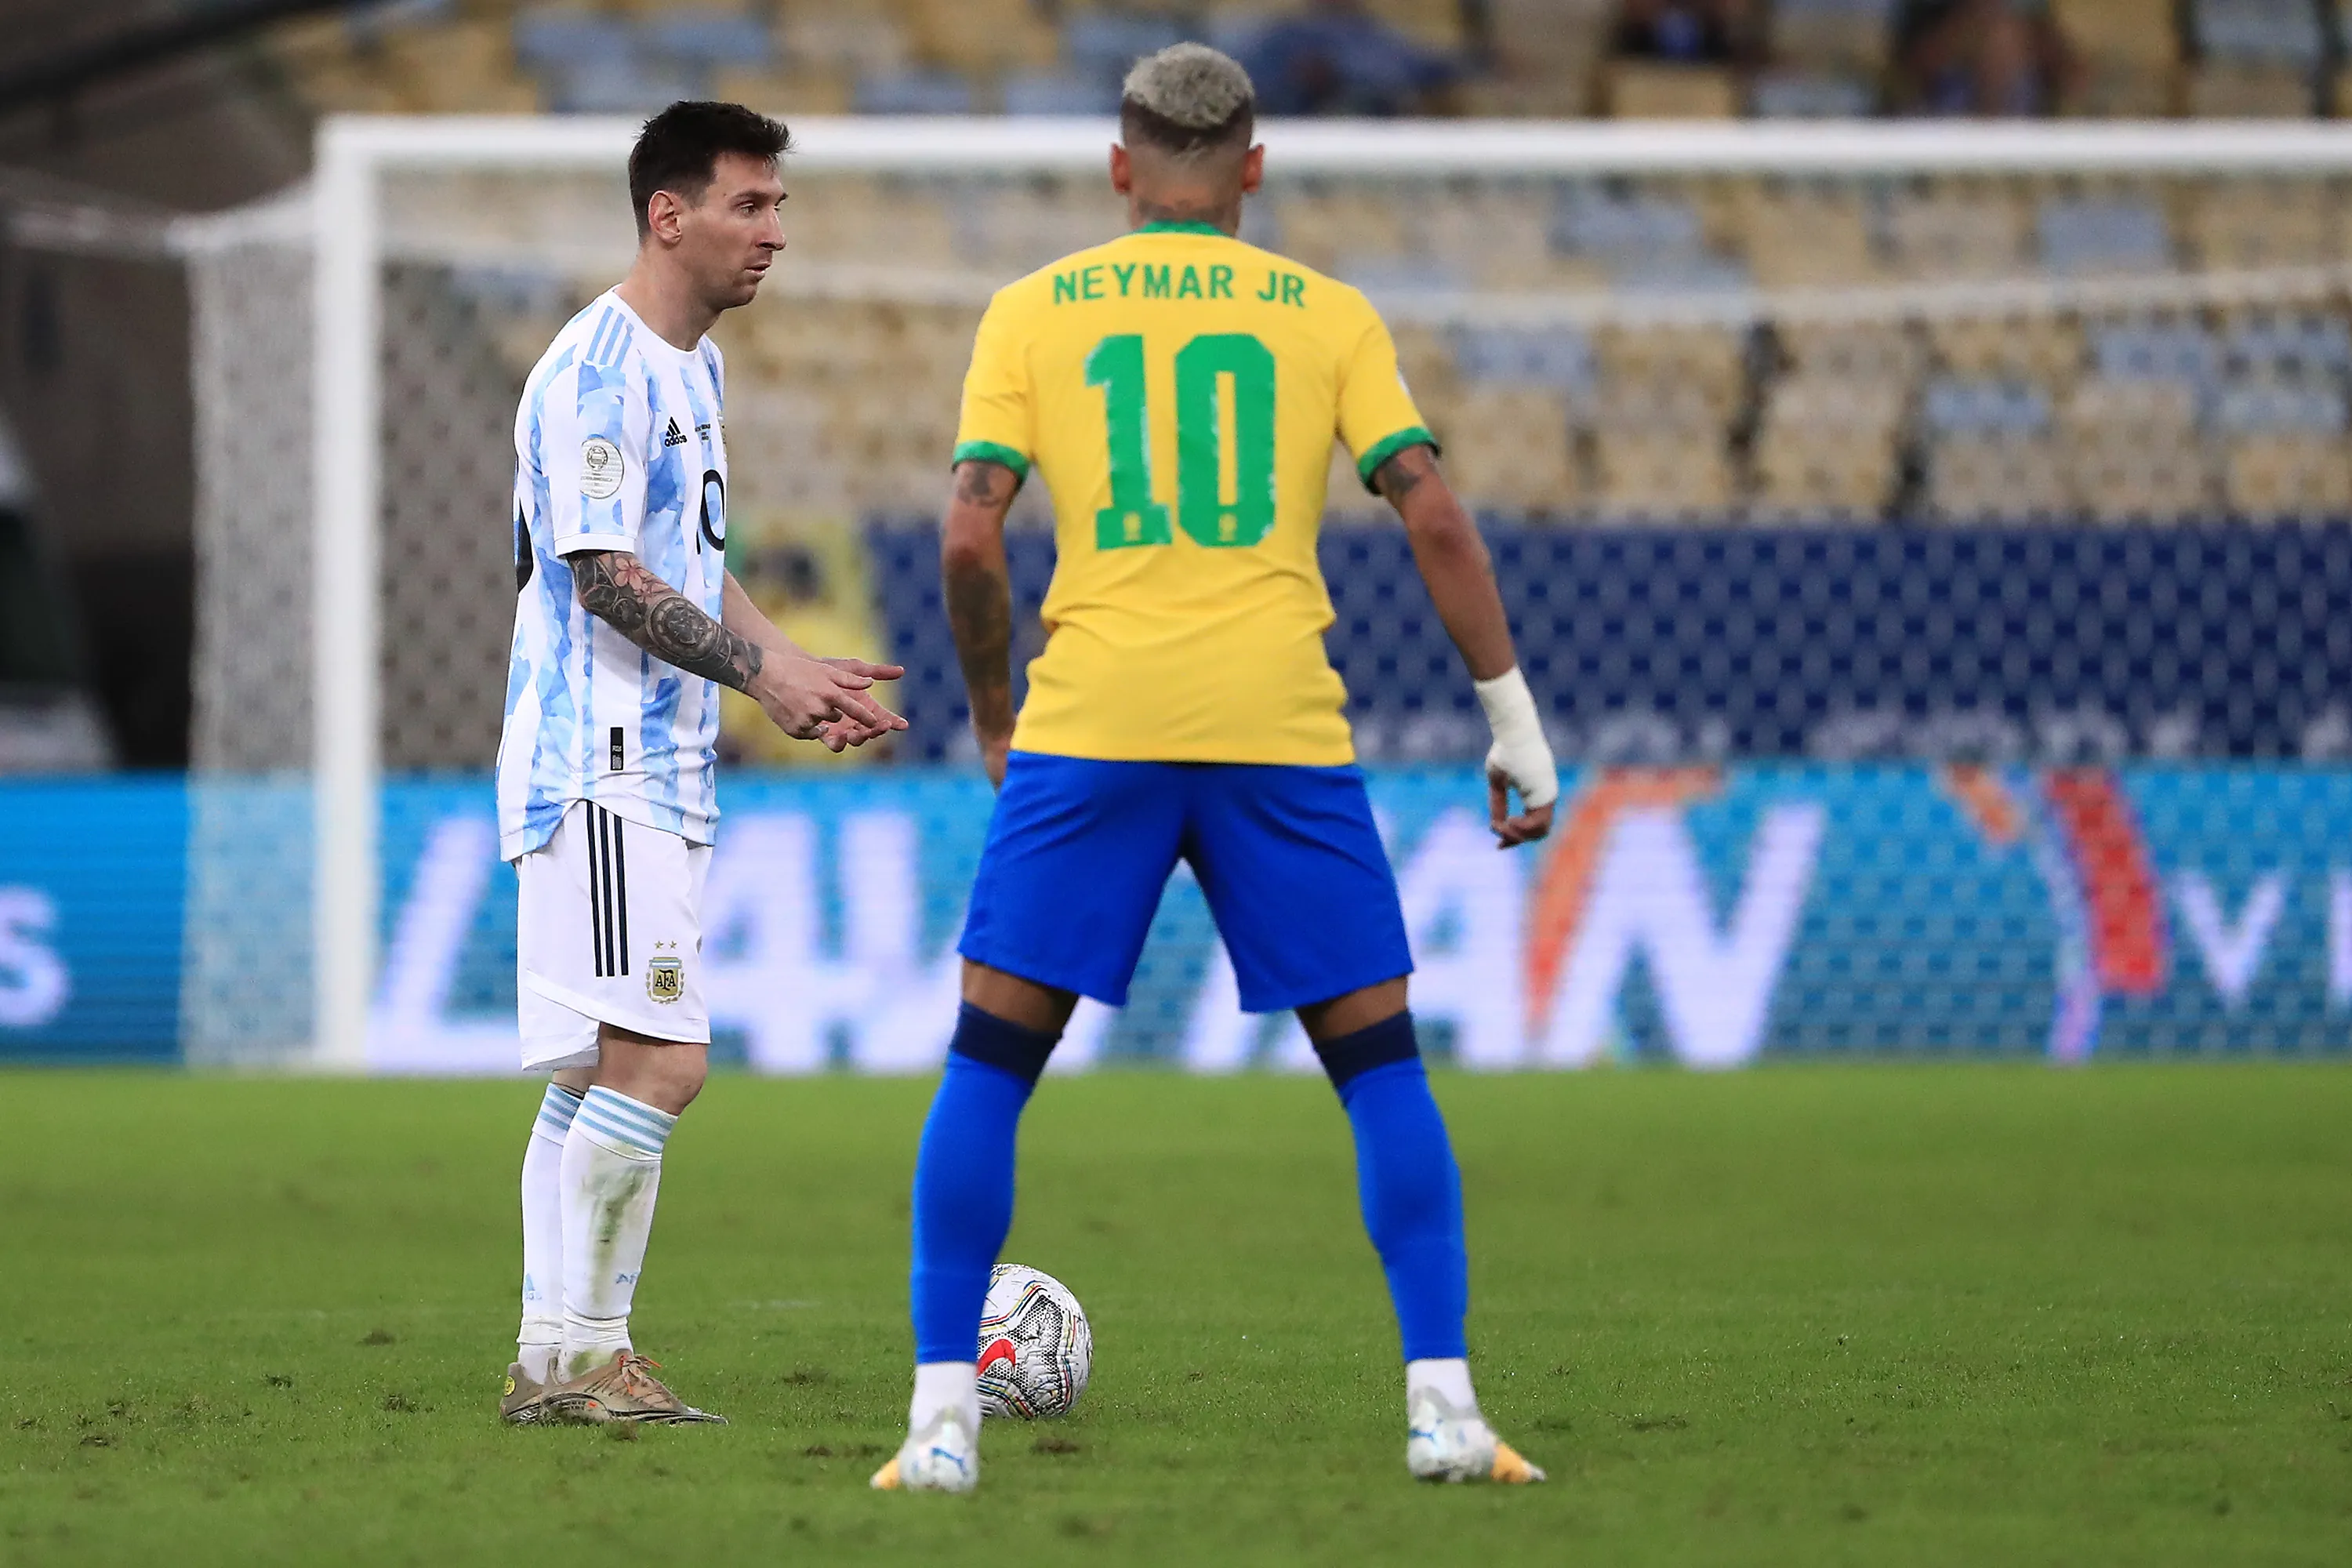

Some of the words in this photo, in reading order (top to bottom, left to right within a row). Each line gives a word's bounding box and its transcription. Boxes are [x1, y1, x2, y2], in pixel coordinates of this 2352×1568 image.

[1053, 263, 1234, 305] NEYMAR
[1255, 270, 1305, 308] JR
[1083, 332, 1276, 550] 10
[655, 969, 676, 991] AFA
